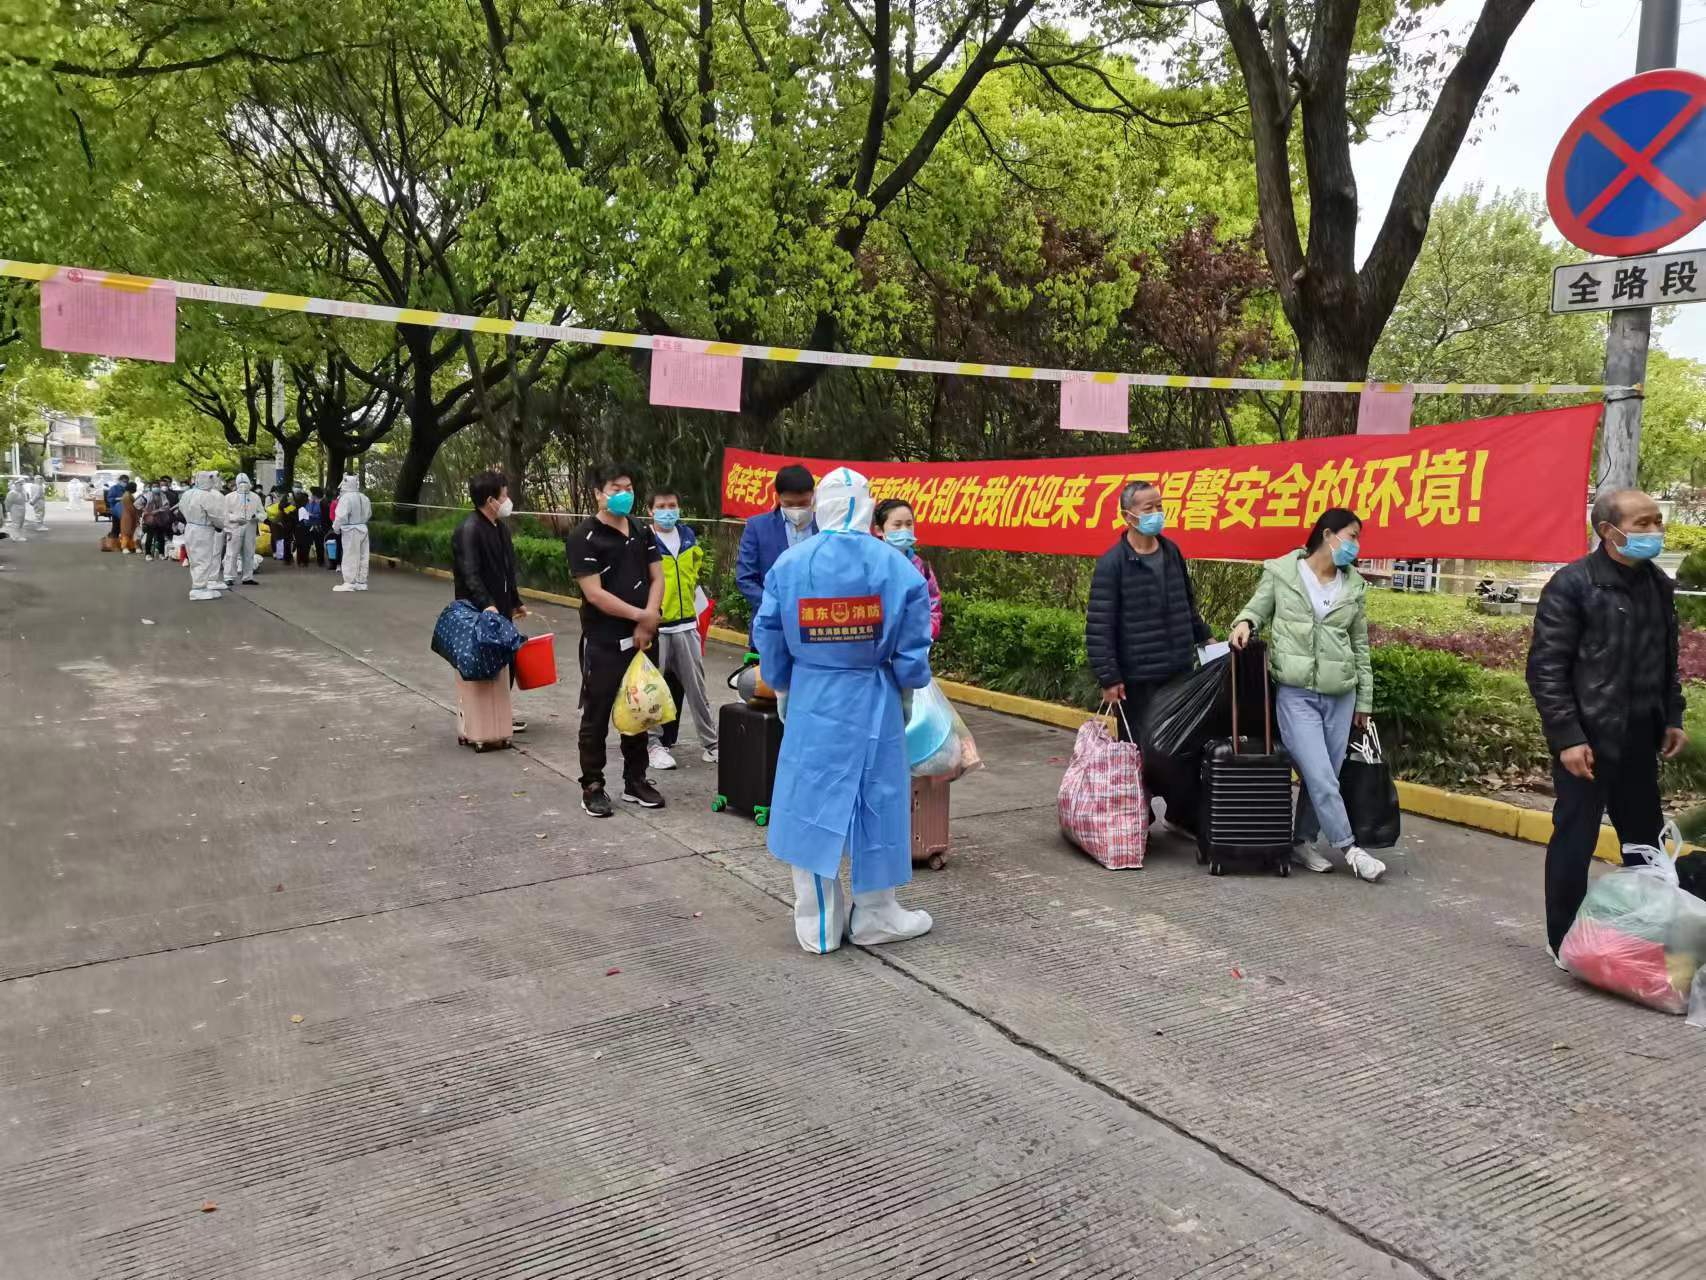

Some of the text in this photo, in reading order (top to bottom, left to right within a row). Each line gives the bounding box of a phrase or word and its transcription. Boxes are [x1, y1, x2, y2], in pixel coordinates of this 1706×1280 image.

[1568, 260, 1697, 304] 全路段
[801, 604, 880, 621] 浦东 消防
